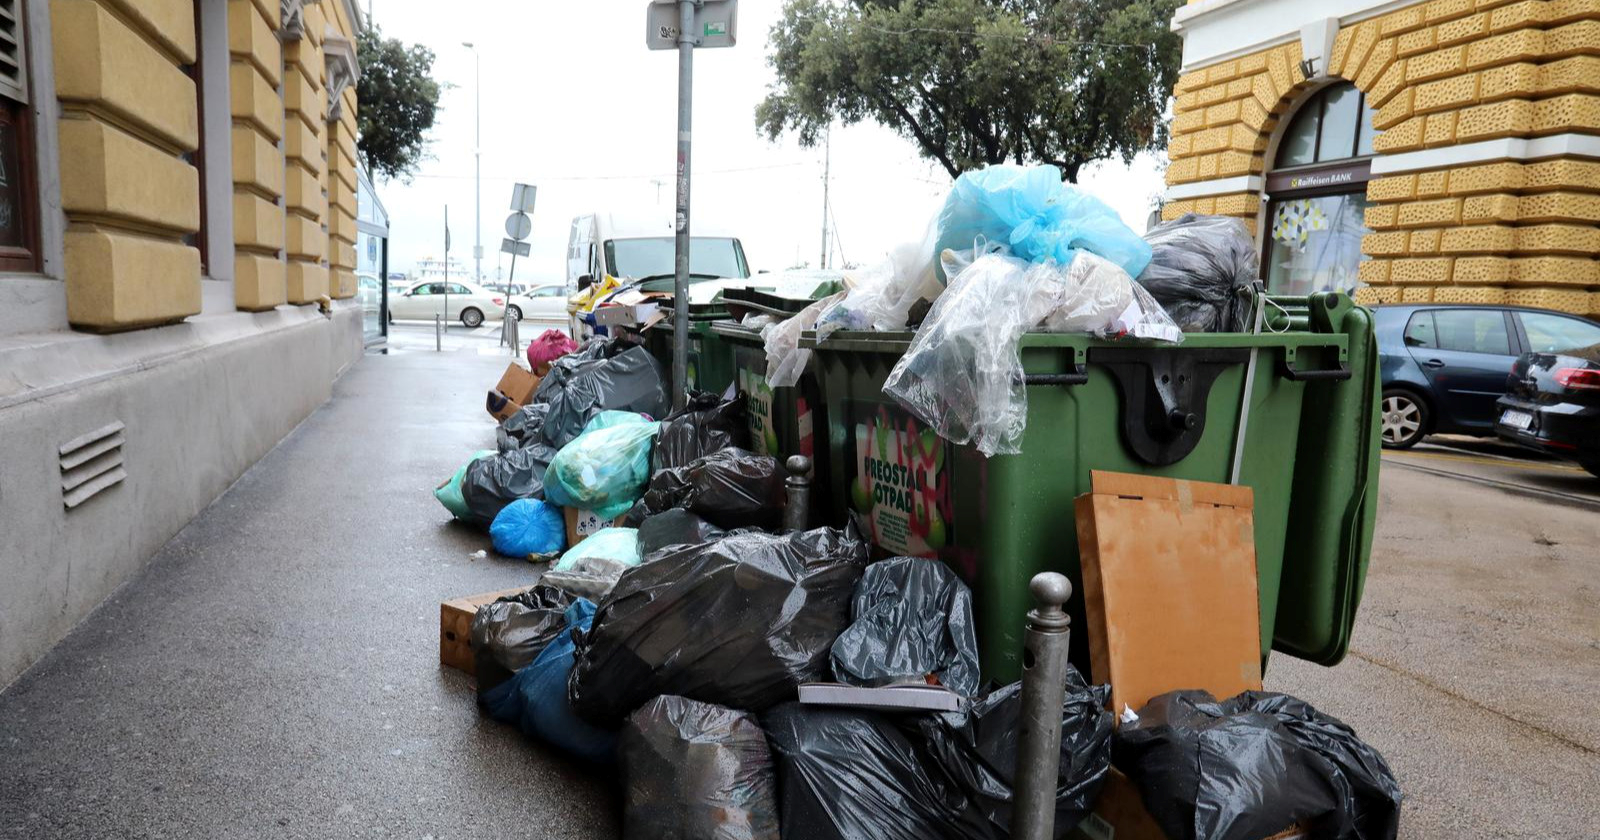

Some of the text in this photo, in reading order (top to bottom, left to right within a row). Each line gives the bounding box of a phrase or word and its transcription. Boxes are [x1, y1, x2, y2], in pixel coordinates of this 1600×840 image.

[1297, 172, 1352, 187] Raiffeisen BANK
[874, 483, 913, 513] OTPAD
